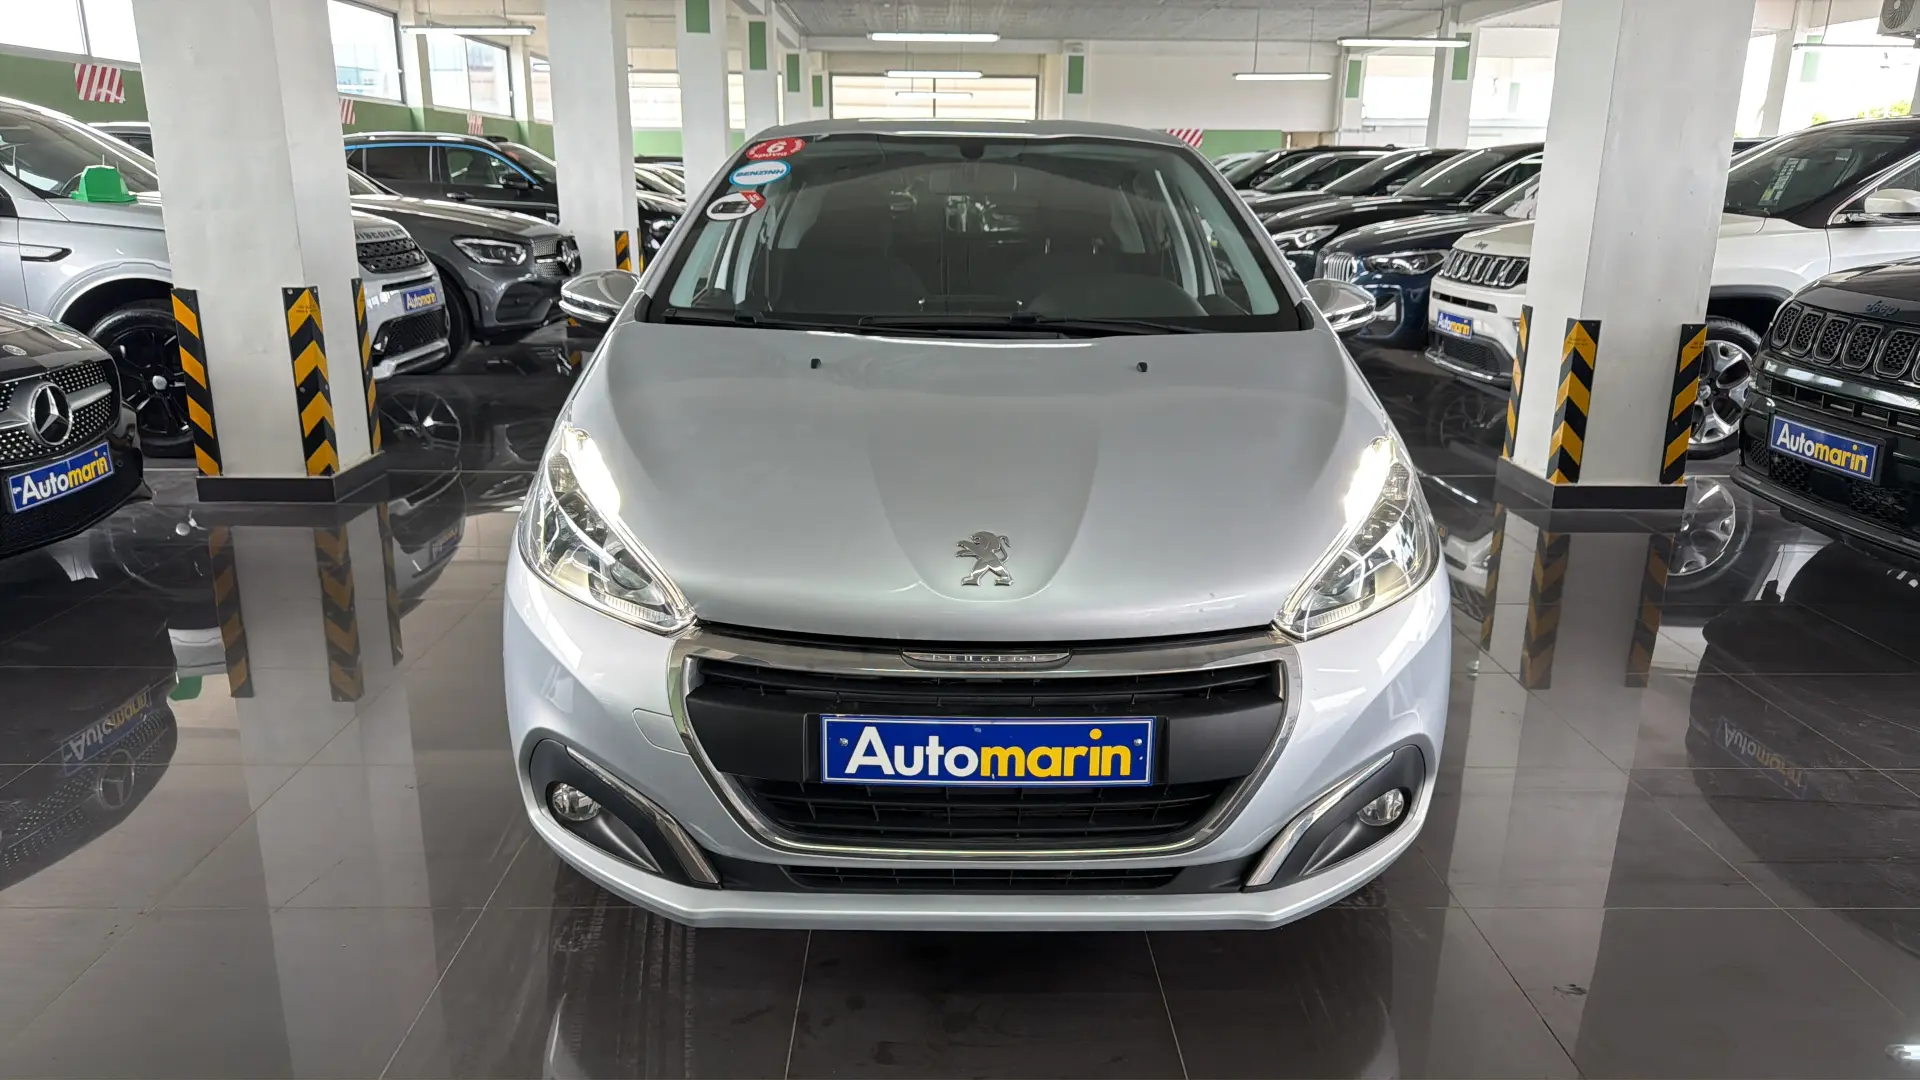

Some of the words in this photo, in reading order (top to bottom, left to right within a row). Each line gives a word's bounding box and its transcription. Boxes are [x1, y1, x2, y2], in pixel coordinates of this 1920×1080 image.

[767, 140, 787, 153] 6
[1865, 300, 1899, 316] Jeep
[1776, 423, 1868, 473] Automarin
[22, 450, 108, 505] Automarin
[844, 726, 1131, 778] Automarin
